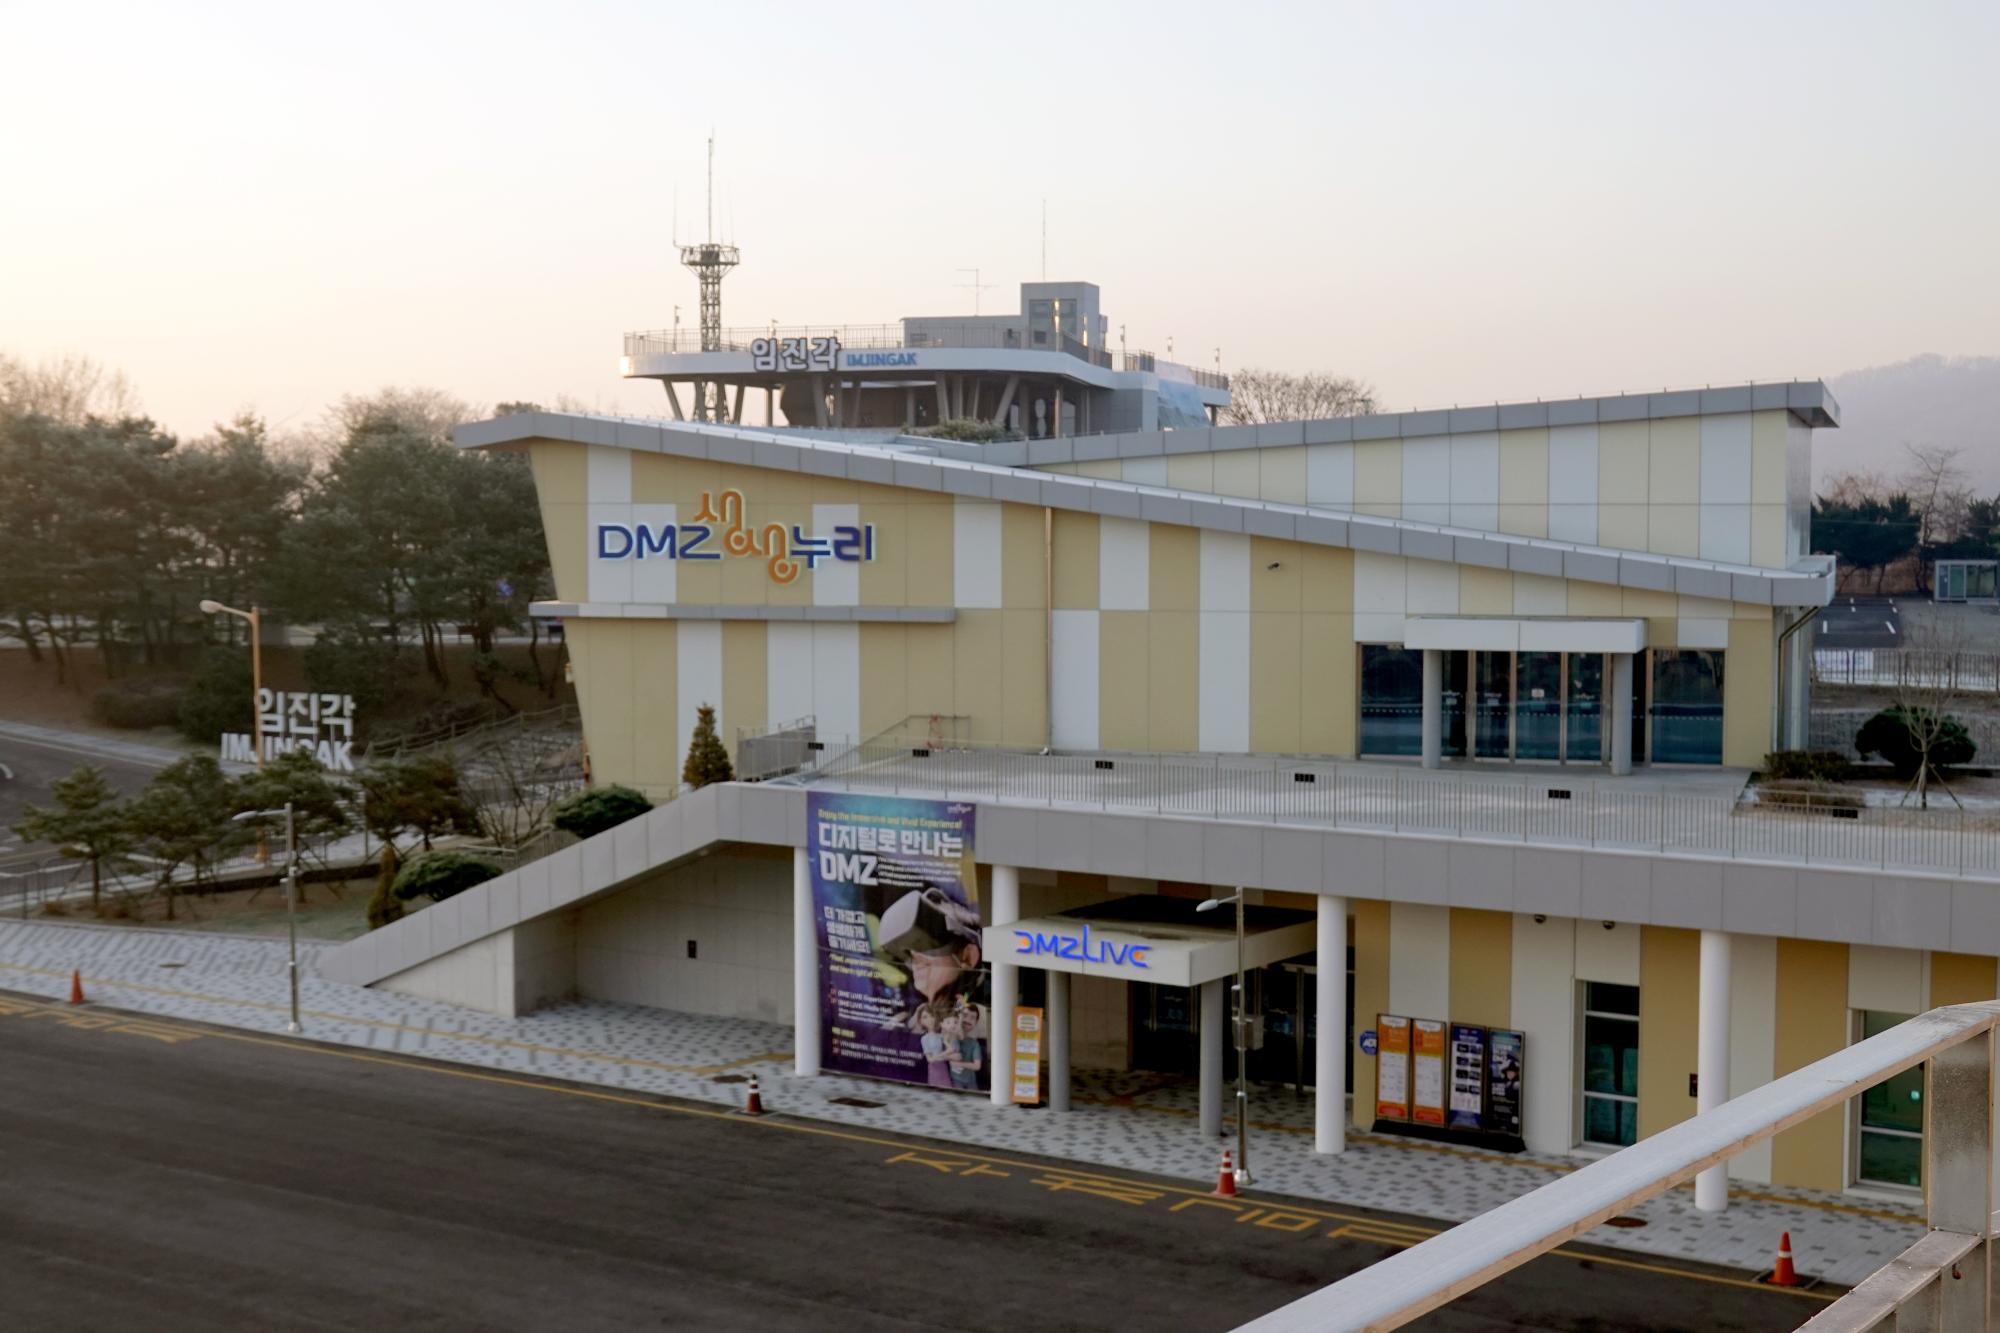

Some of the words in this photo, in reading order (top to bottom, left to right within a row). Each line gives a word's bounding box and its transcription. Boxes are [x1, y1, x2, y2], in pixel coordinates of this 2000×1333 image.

[751, 336, 841, 371] 임진각
[846, 353, 917, 366] IMJINGAK
[598, 525, 720, 559] DMZ
[254, 687, 356, 736] 임진각
[818, 822, 897, 853] 디지털로
[901, 829, 962, 857] 만나는
[819, 851, 878, 886] DMZ
